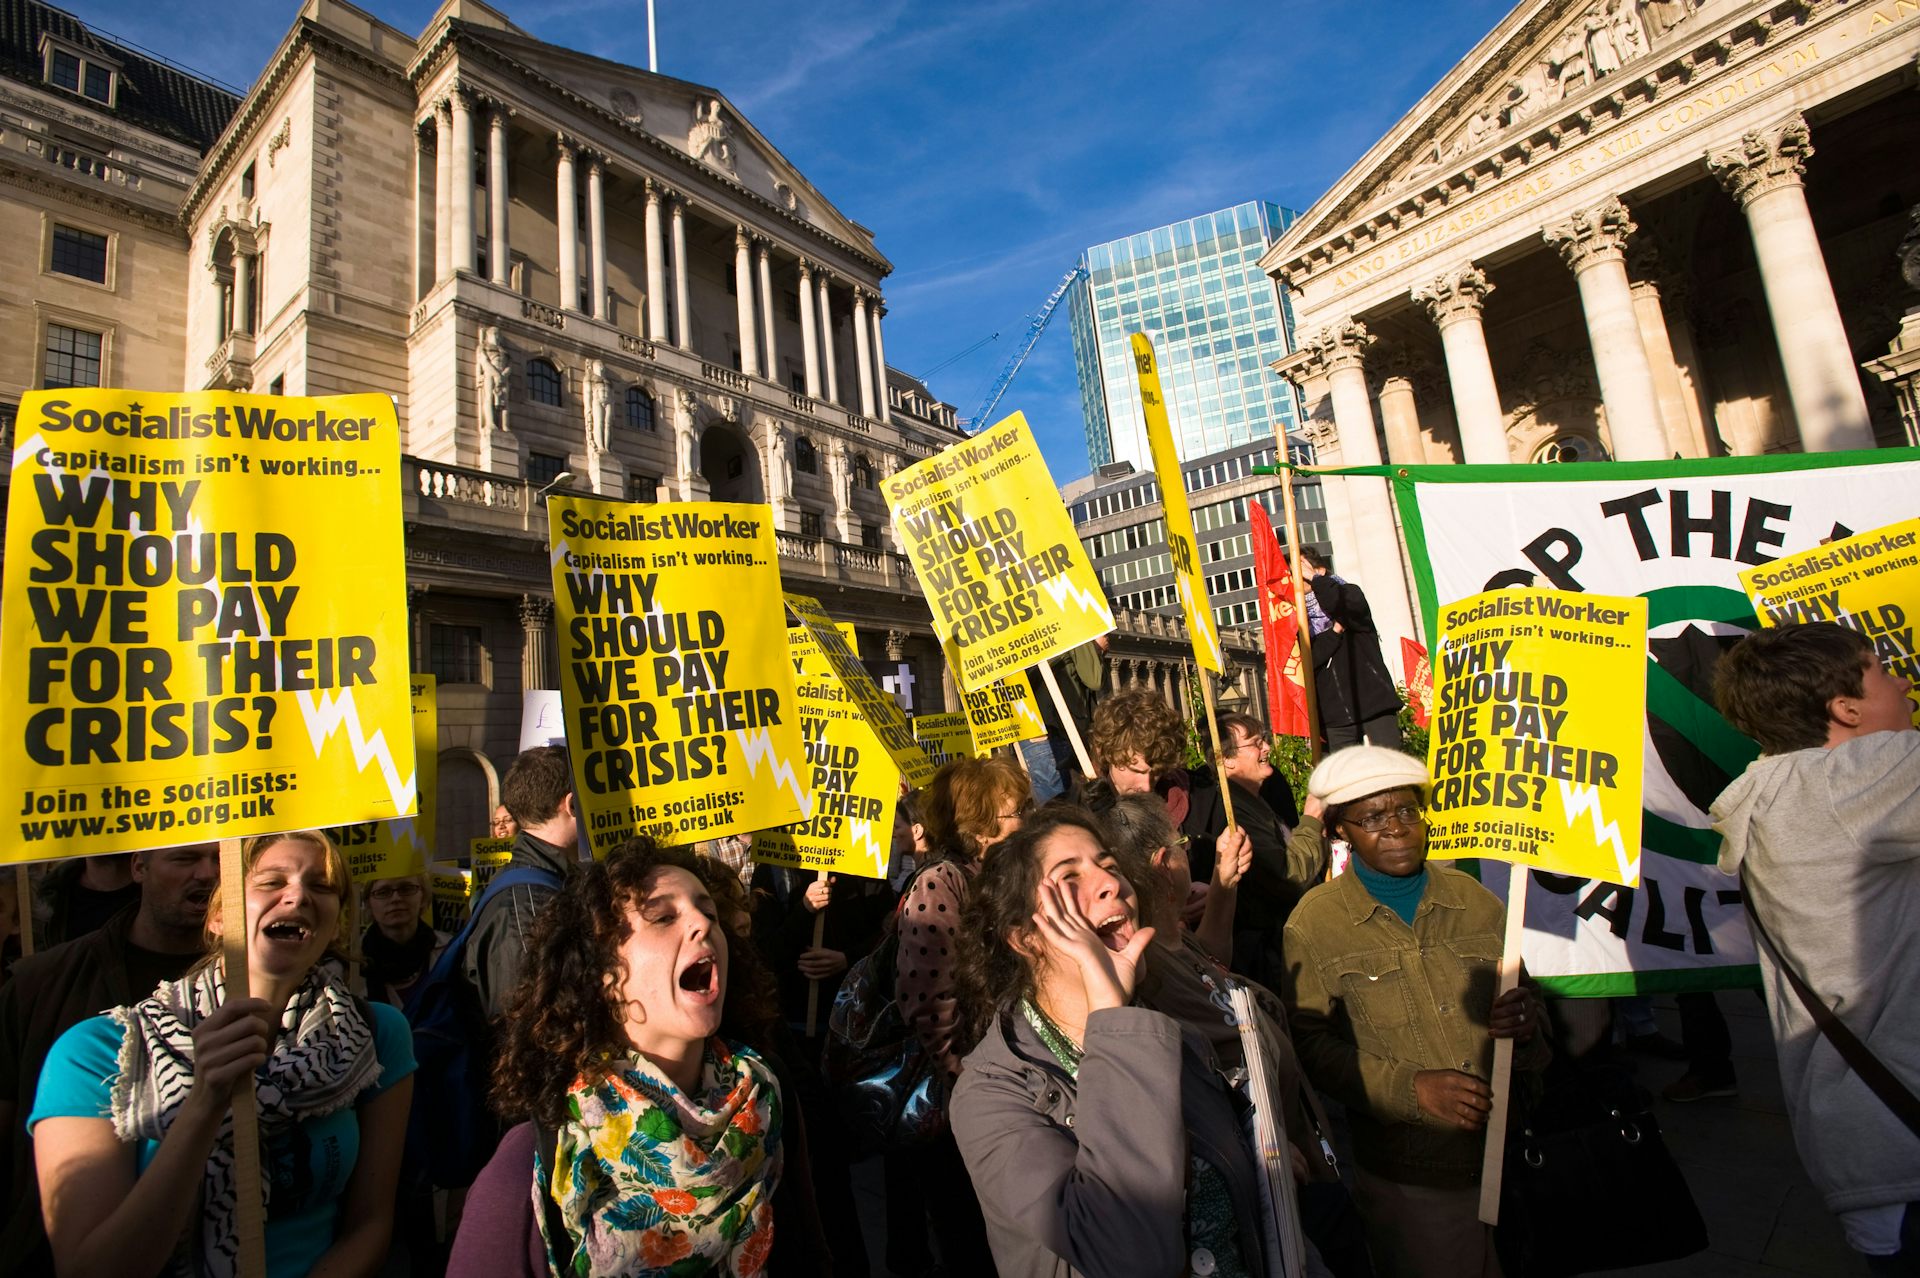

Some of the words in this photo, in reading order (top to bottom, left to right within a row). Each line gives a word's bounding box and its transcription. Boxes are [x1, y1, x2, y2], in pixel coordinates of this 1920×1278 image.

[1334, 255, 1386, 292] ANNO
[1568, 158, 1586, 177] R
[1655, 42, 1821, 133] CONDITVM
[35, 447, 185, 475] Capitalism
[195, 453, 249, 474] isn't
[260, 456, 380, 476] working...
[32, 474, 200, 531] WHY
[900, 489, 952, 517] Capitalism
[955, 475, 979, 493] isn't
[980, 453, 1031, 481] working...
[904, 497, 967, 543] WHY
[916, 508, 1017, 571] SHOULD
[1600, 487, 1792, 567] THE
[30, 529, 296, 587] SHOULD
[564, 550, 645, 570] Capitalism
[652, 552, 688, 568] isn't
[694, 551, 768, 566] working...
[926, 557, 973, 595] WE
[978, 531, 1027, 576] PAY
[565, 573, 658, 614] WHY
[937, 580, 993, 623] FOR
[993, 543, 1074, 597] THEIR
[1762, 582, 1827, 607] Capitalism
[1830, 571, 1860, 588] isn't
[27, 587, 148, 643] WE
[177, 586, 299, 641] PAY
[950, 589, 1043, 648] CRISIS?
[1766, 590, 1842, 628] WHY
[1837, 603, 1906, 636] ULD
[570, 610, 724, 659] SHOULD
[964, 652, 984, 670] Join
[986, 644, 1006, 659] the
[1008, 622, 1061, 650] socialists:
[1444, 627, 1503, 650] Capitalism
[1510, 625, 1544, 638] isn't
[1550, 629, 1631, 648] working...
[1875, 627, 1916, 661] AY
[28, 648, 172, 703] FOR
[198, 636, 377, 696] THEIR
[571, 659, 639, 703] WE
[653, 650, 729, 696] PAY
[968, 636, 1057, 681] www.swp.org.uk
[1443, 640, 1514, 682] WHY
[797, 681, 844, 702] cialist
[799, 705, 824, 716] alism
[827, 707, 848, 719] isn't
[964, 690, 989, 709] FOR
[992, 684, 1027, 703] THEIR
[1439, 671, 1568, 714] SHOULD
[24, 696, 276, 766] CRISIS?
[579, 701, 657, 750] FOR
[672, 688, 782, 736] THEIR
[800, 717, 829, 742] HY
[971, 703, 1014, 726] CRISIS?
[1437, 705, 1477, 745] WE
[1490, 705, 1568, 741] PAY
[584, 735, 727, 794] CRISIS?
[806, 741, 859, 768] OULD
[1434, 739, 1487, 779] FOR
[1501, 738, 1618, 789] THEIR
[21, 791, 87, 816] Join
[101, 786, 150, 809] the
[163, 772, 298, 804] socialists:
[812, 767, 858, 792] PAY
[1431, 772, 1547, 812] CRISIS?
[20, 795, 275, 842] www.swp.org.uk
[591, 811, 623, 830] Join
[628, 806, 659, 823] the
[663, 790, 745, 816] socialists:
[818, 791, 883, 821] THEIR
[475, 842, 513, 854] Sociali
[758, 838, 777, 849] Join
[780, 841, 795, 852] the
[799, 845, 845, 857] socialists:
[1451, 821, 1469, 835] the
[1473, 820, 1555, 843] socialists:
[348, 852, 388, 865] ialists:
[757, 849, 836, 865] www.swp.org.uk
